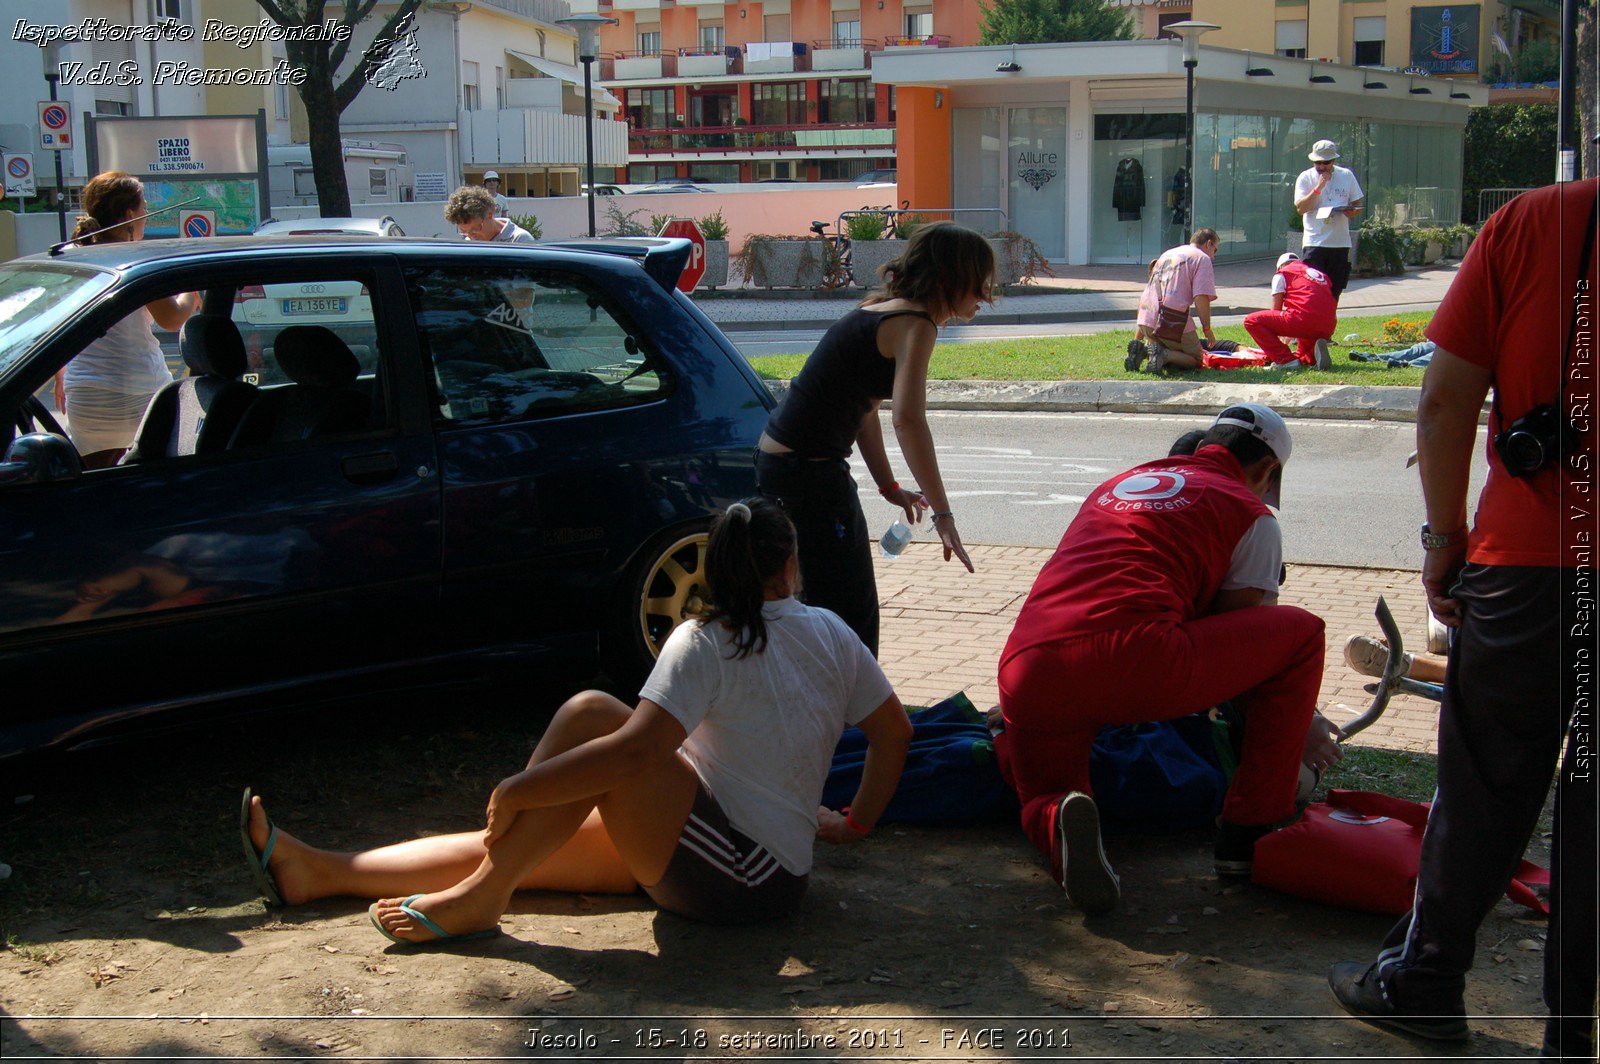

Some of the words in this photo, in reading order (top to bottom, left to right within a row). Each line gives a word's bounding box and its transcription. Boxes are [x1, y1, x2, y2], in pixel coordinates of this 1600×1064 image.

[158, 139, 189, 147] SPAZIO
[160, 148, 189, 156] LIBERO
[1018, 152, 1057, 163] Allure
[1114, 496, 1191, 511] Crescent
